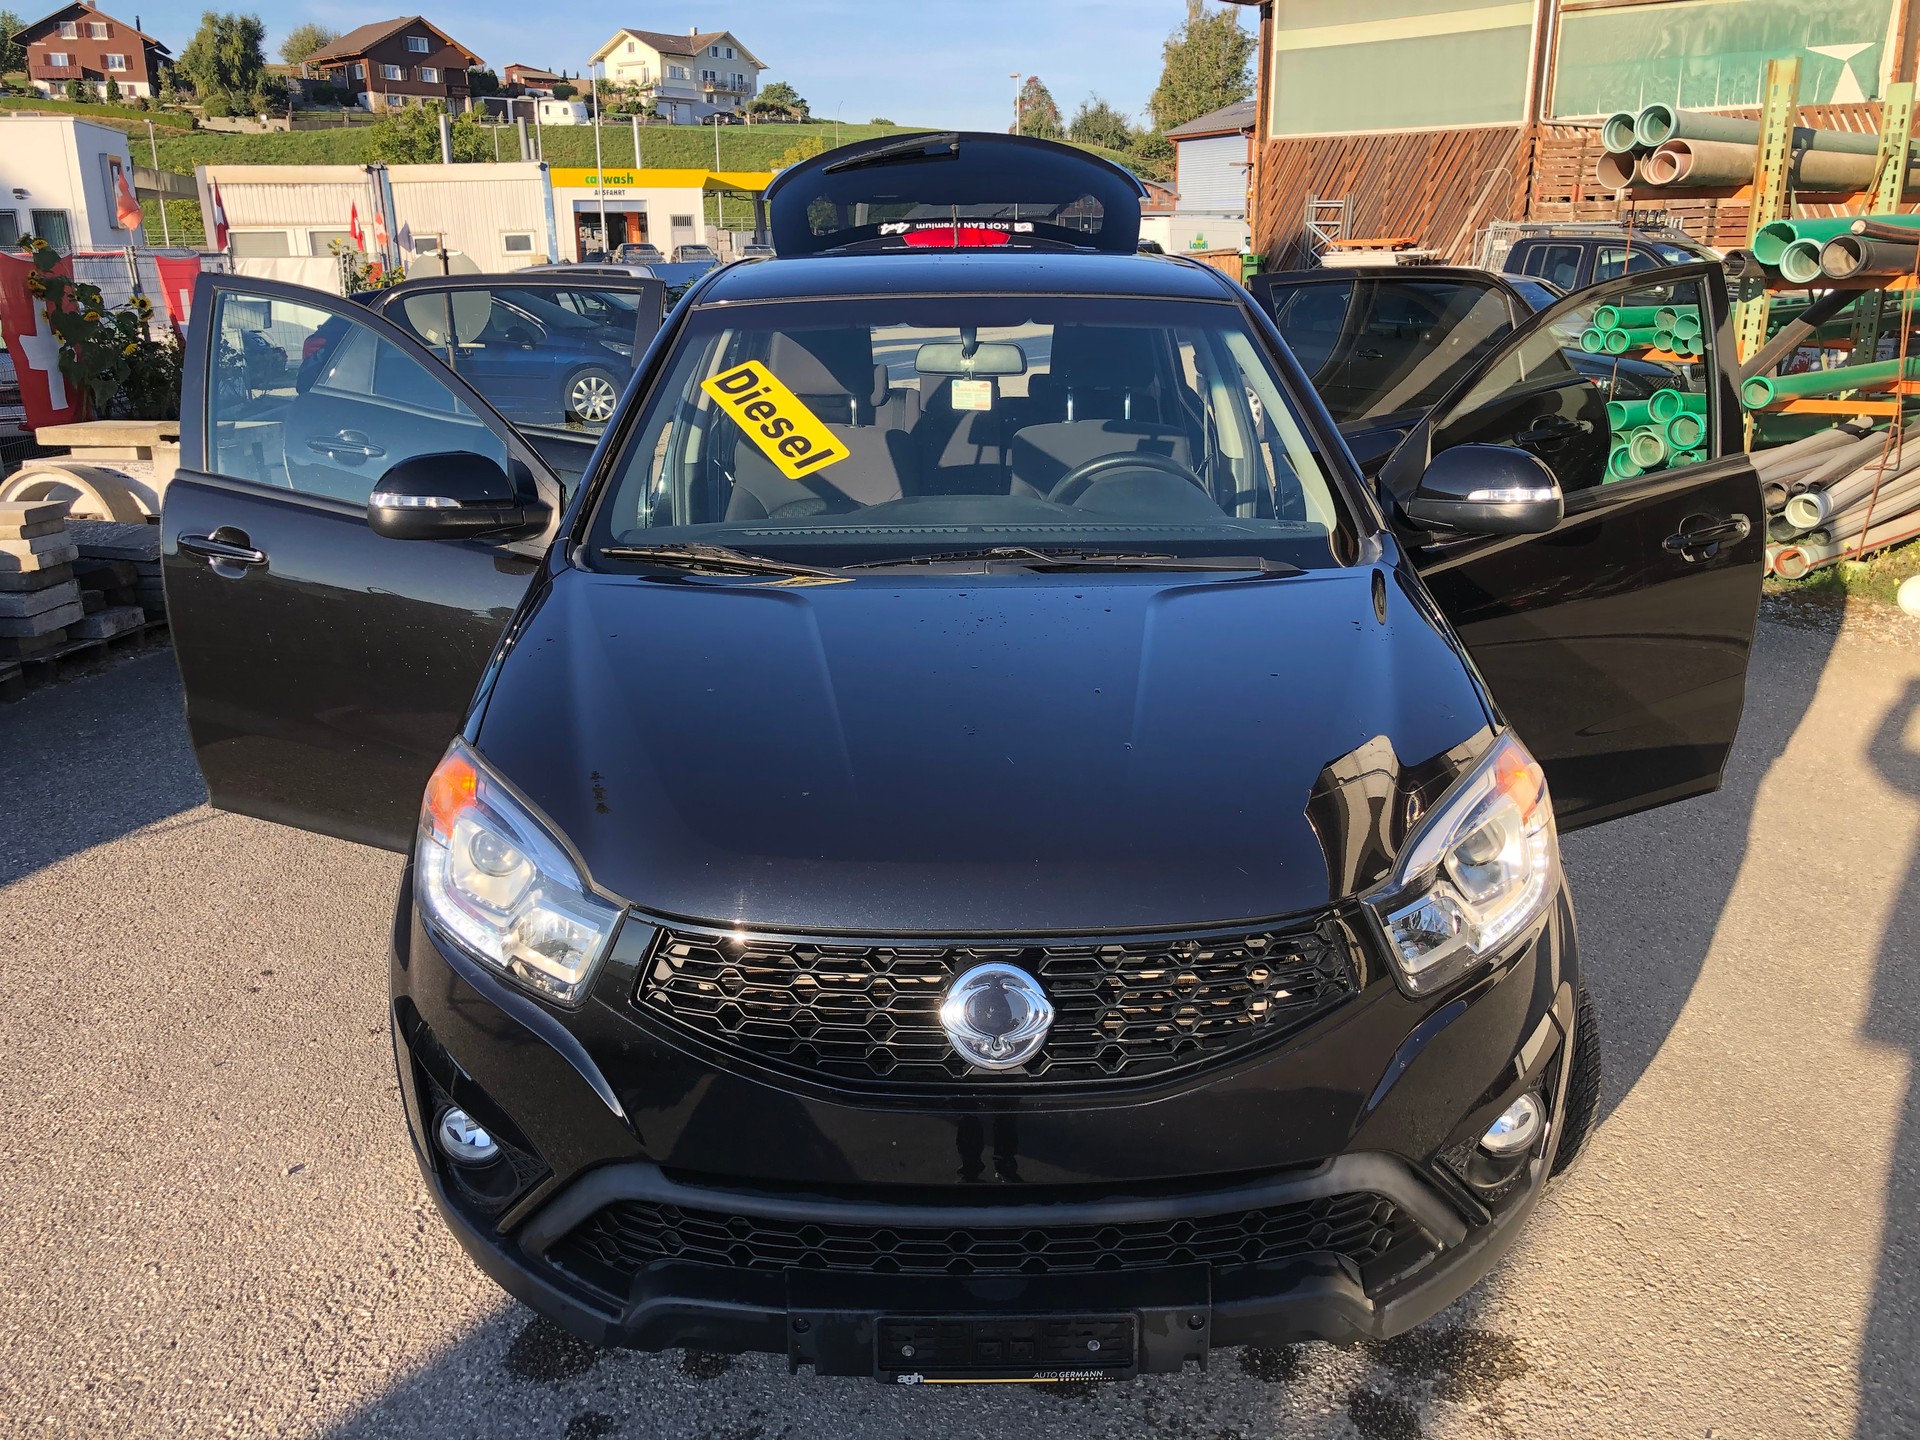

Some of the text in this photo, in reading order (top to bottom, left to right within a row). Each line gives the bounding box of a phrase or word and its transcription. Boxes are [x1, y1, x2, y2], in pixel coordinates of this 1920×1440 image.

[585, 172, 634, 184] cawash
[880, 222, 910, 235] 4x4
[963, 222, 1009, 230] KOREAN
[1189, 240, 1209, 250] Landi
[713, 367, 835, 471] Diesel
[897, 1372, 924, 1385] agh
[1033, 1370, 1104, 1379] AUTO GERMANN
